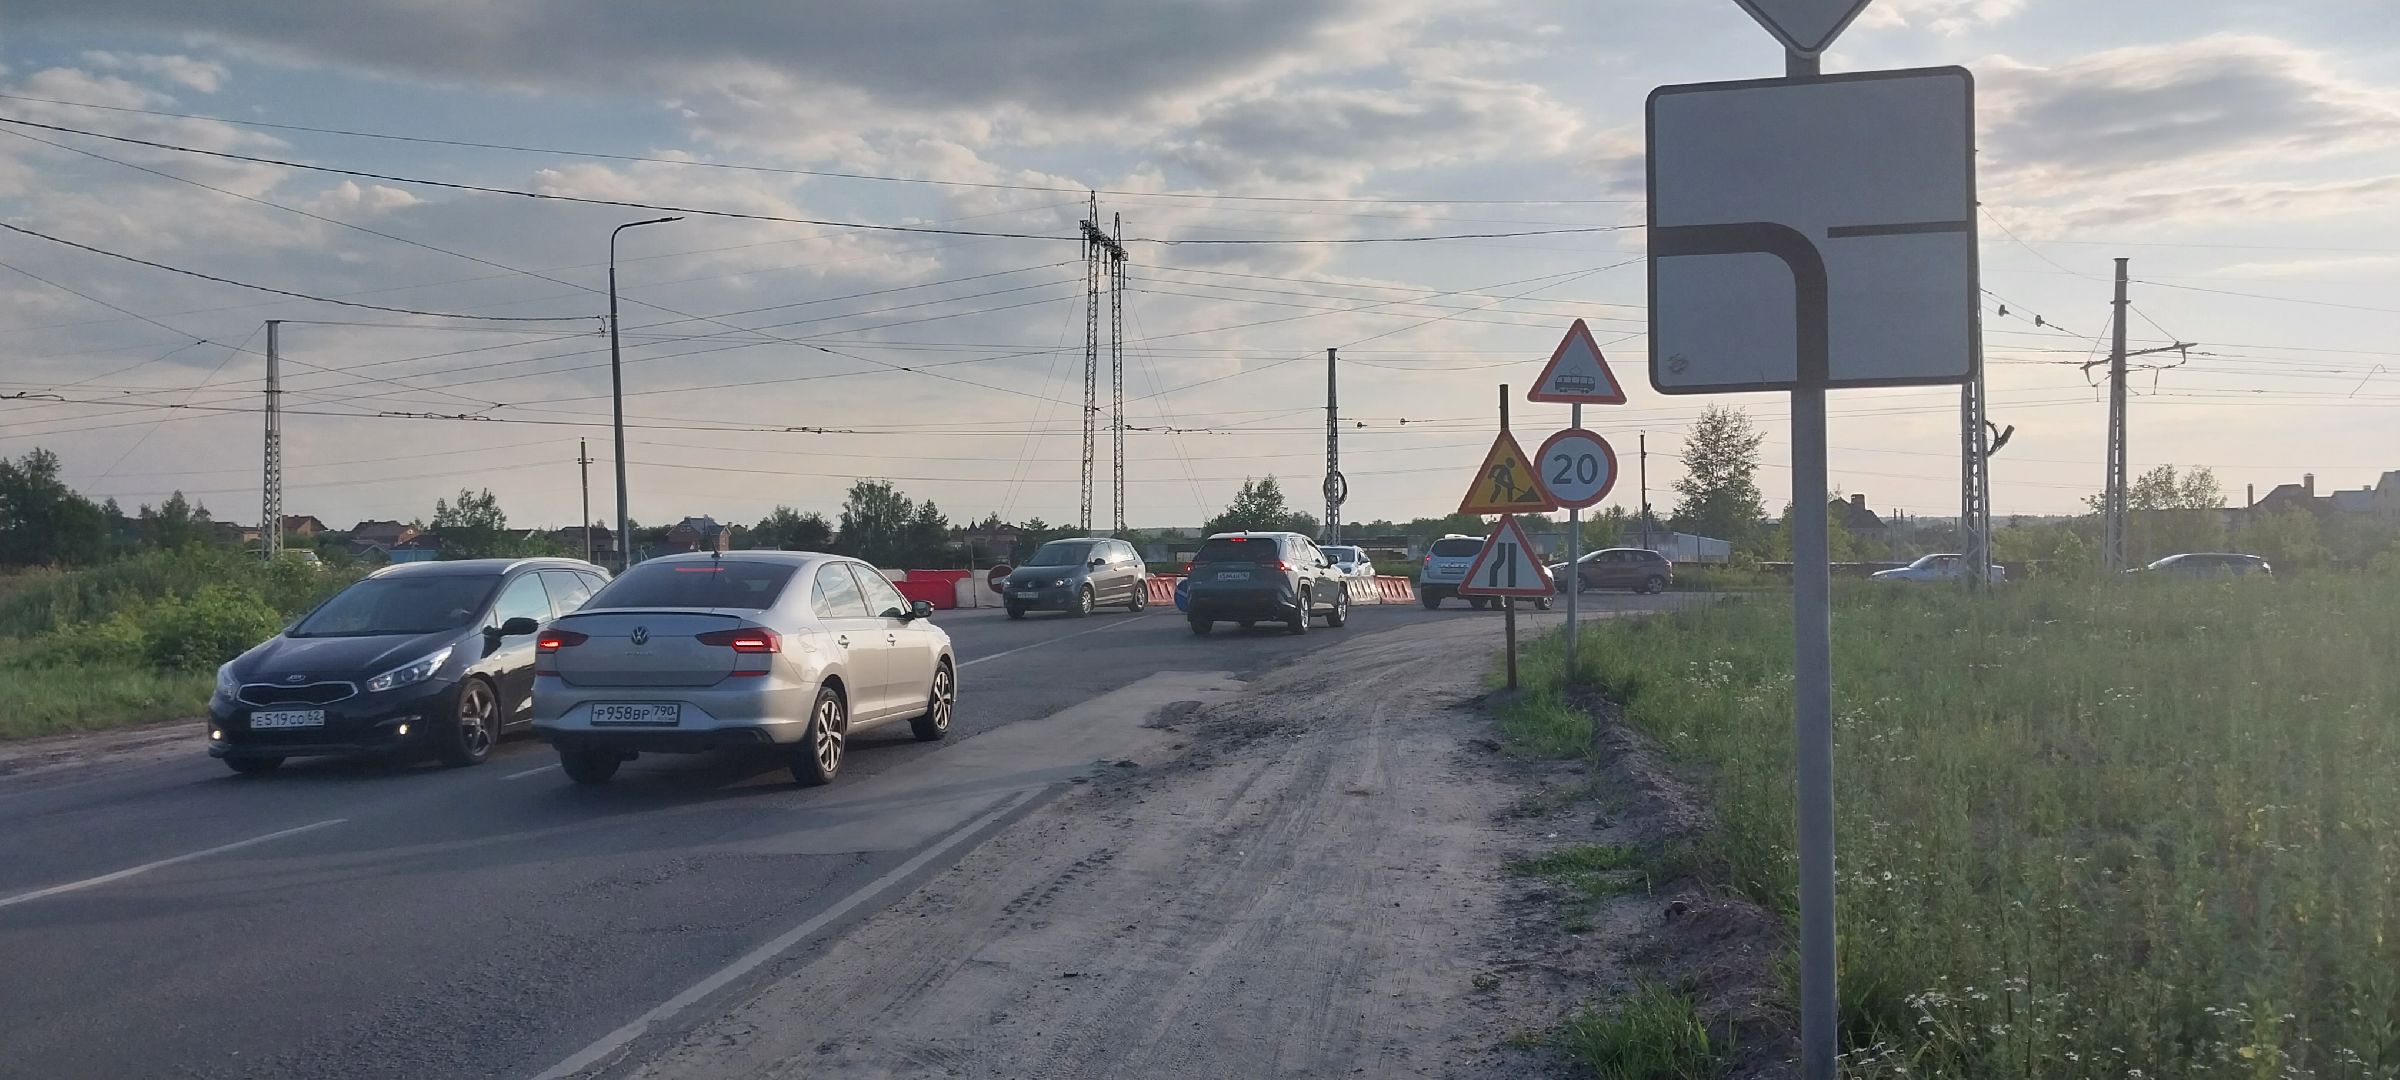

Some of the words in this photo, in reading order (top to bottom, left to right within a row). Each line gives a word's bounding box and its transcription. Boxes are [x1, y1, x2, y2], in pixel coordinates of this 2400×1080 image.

[1552, 453, 1598, 484] 20
[256, 713, 305, 726] Е519СО
[307, 710, 321, 721] 62
[597, 706, 650, 720] Р958ВР
[653, 705, 675, 716] 790
